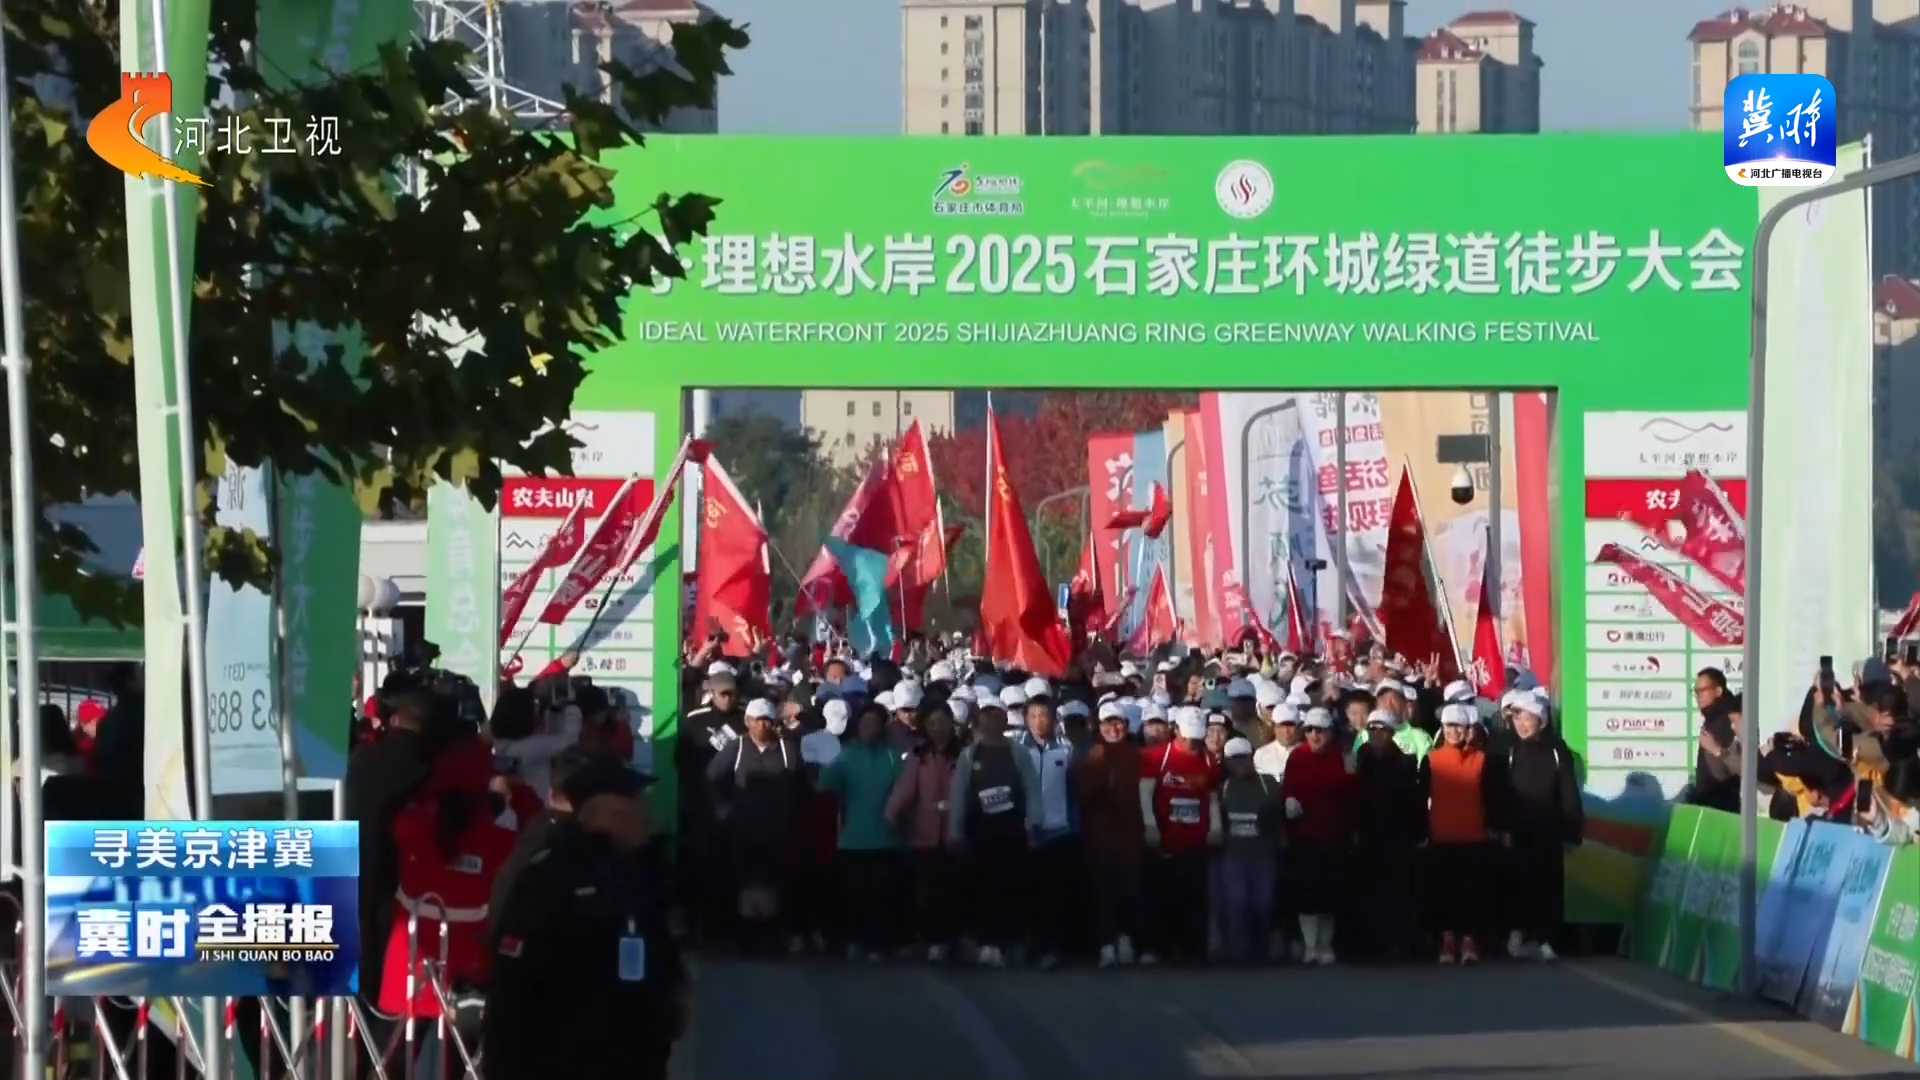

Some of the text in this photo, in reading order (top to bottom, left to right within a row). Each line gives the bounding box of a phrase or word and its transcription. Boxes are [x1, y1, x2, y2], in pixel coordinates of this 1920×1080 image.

[622, 229, 1744, 296] ·理想水岸2025石家庄环城绿道徒步大会
[639, 321, 1600, 342] IDEAL WATERFRONT 2025 SHIJIAZHUANG RING GREENWAY WALKING FESTIVAL
